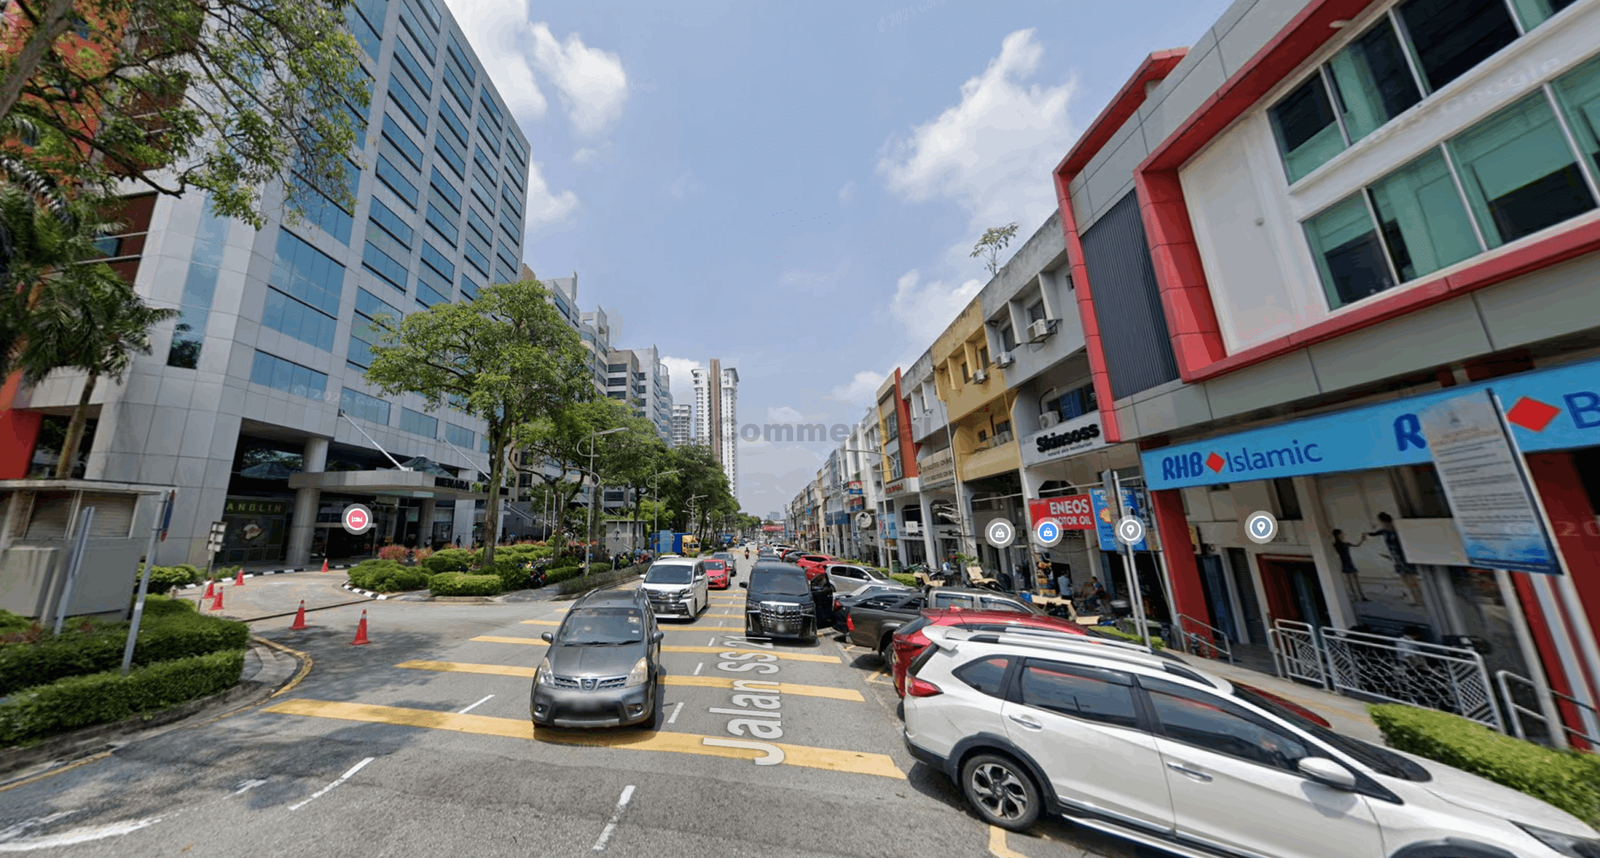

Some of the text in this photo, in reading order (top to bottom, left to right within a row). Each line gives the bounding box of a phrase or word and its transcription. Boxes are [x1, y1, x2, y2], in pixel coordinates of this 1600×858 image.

[1036, 423, 1100, 453] Skinsoss
[1393, 413, 1427, 451] R
[1162, 439, 1323, 481] RHB Islamic
[1049, 498, 1090, 515] ENEOS
[1052, 515, 1093, 526] MOTOR OIL
